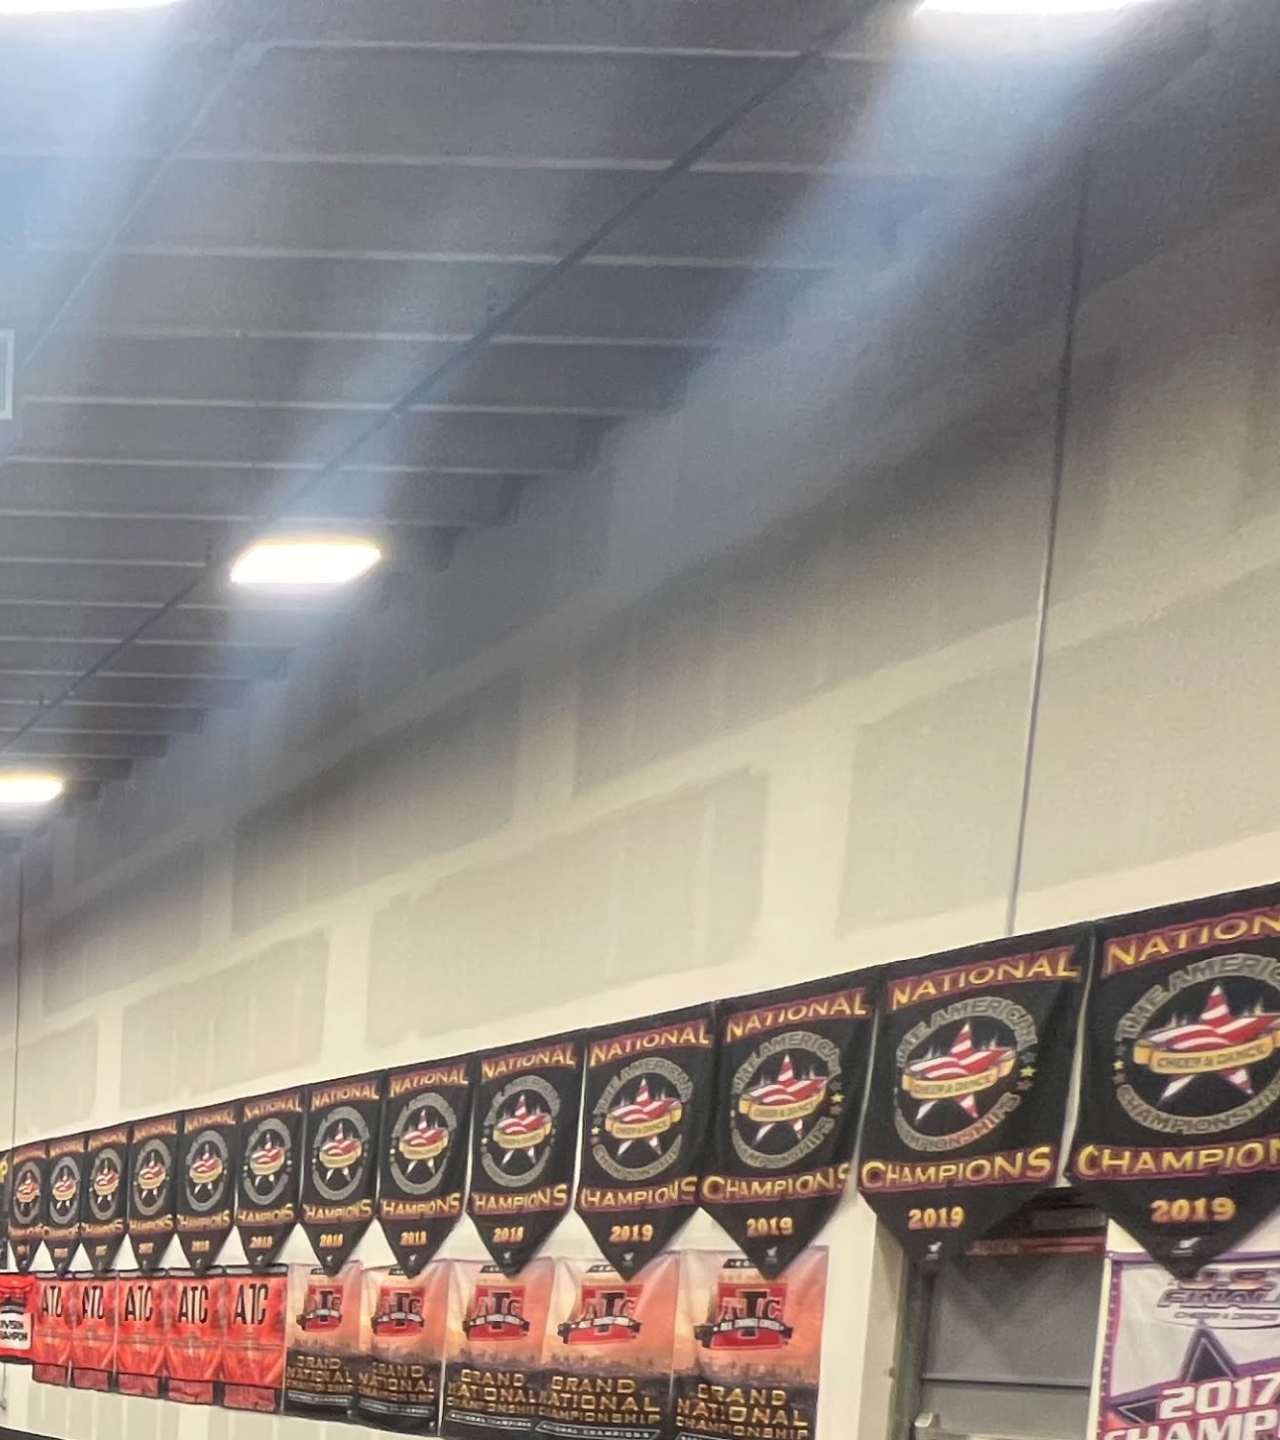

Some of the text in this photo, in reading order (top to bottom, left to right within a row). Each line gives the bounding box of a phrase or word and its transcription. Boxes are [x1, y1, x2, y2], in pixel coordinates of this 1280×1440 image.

[892, 952, 1079, 1010] NATIONAL
[726, 993, 867, 1042] NATIONAL
[590, 1022, 710, 1066] NATIONAL
[482, 1048, 575, 1082] NATIONAL
[391, 1066, 468, 1097] NATIONAL
[702, 1163, 851, 1199] CHAMPIONS
[861, 1146, 1051, 1188] CHAMPIONS
[305, 1199, 371, 1219] HAMPIONS
[383, 1193, 460, 1216] HAMPIONS
[475, 1184, 567, 1210] HAMPIONS
[1150, 1197, 1236, 1223] 2019
[610, 1225, 654, 1242] 2019
[747, 1217, 793, 1237] 2019
[908, 1207, 965, 1230] 2019
[125, 1285, 152, 1321] ATC
[178, 1285, 209, 1324] ATC
[235, 1284, 268, 1325] ATC
[461, 1369, 526, 1387] GRAND
[551, 1376, 636, 1394] GRAND
[697, 1383, 787, 1406] GRAND
[1159, 1371, 1280, 1419] 2017
[677, 1397, 808, 1427] NATIONAL
[676, 1416, 808, 1440] CHAMPIONSHIP
